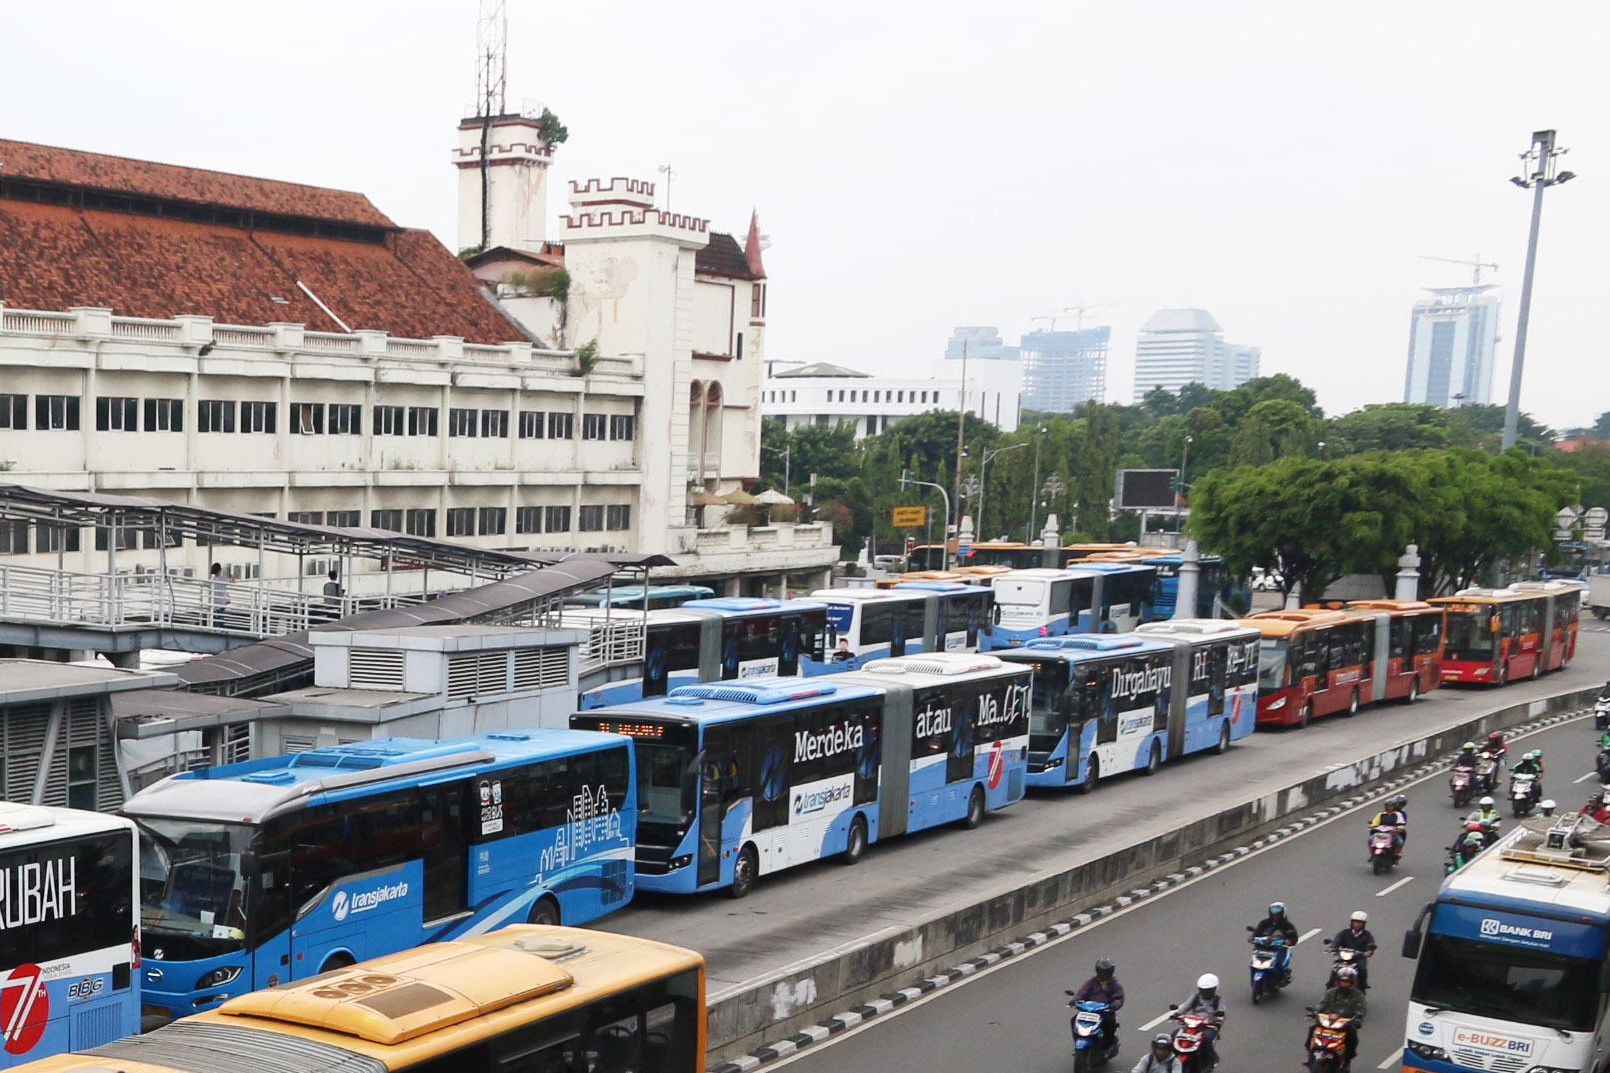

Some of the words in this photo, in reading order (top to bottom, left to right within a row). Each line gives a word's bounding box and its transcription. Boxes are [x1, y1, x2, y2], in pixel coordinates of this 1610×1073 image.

[1111, 663, 1171, 700] Dirgahayu
[793, 721, 864, 763] Merdeka
[916, 704, 952, 739] atau
[802, 783, 851, 815] transjakarta
[350, 881, 409, 914] transjakarta
[1499, 924, 1533, 938] BANK
[1532, 930, 1553, 940] BRI
[38, 989, 47, 998] TH
[67, 977, 104, 999] BBG
